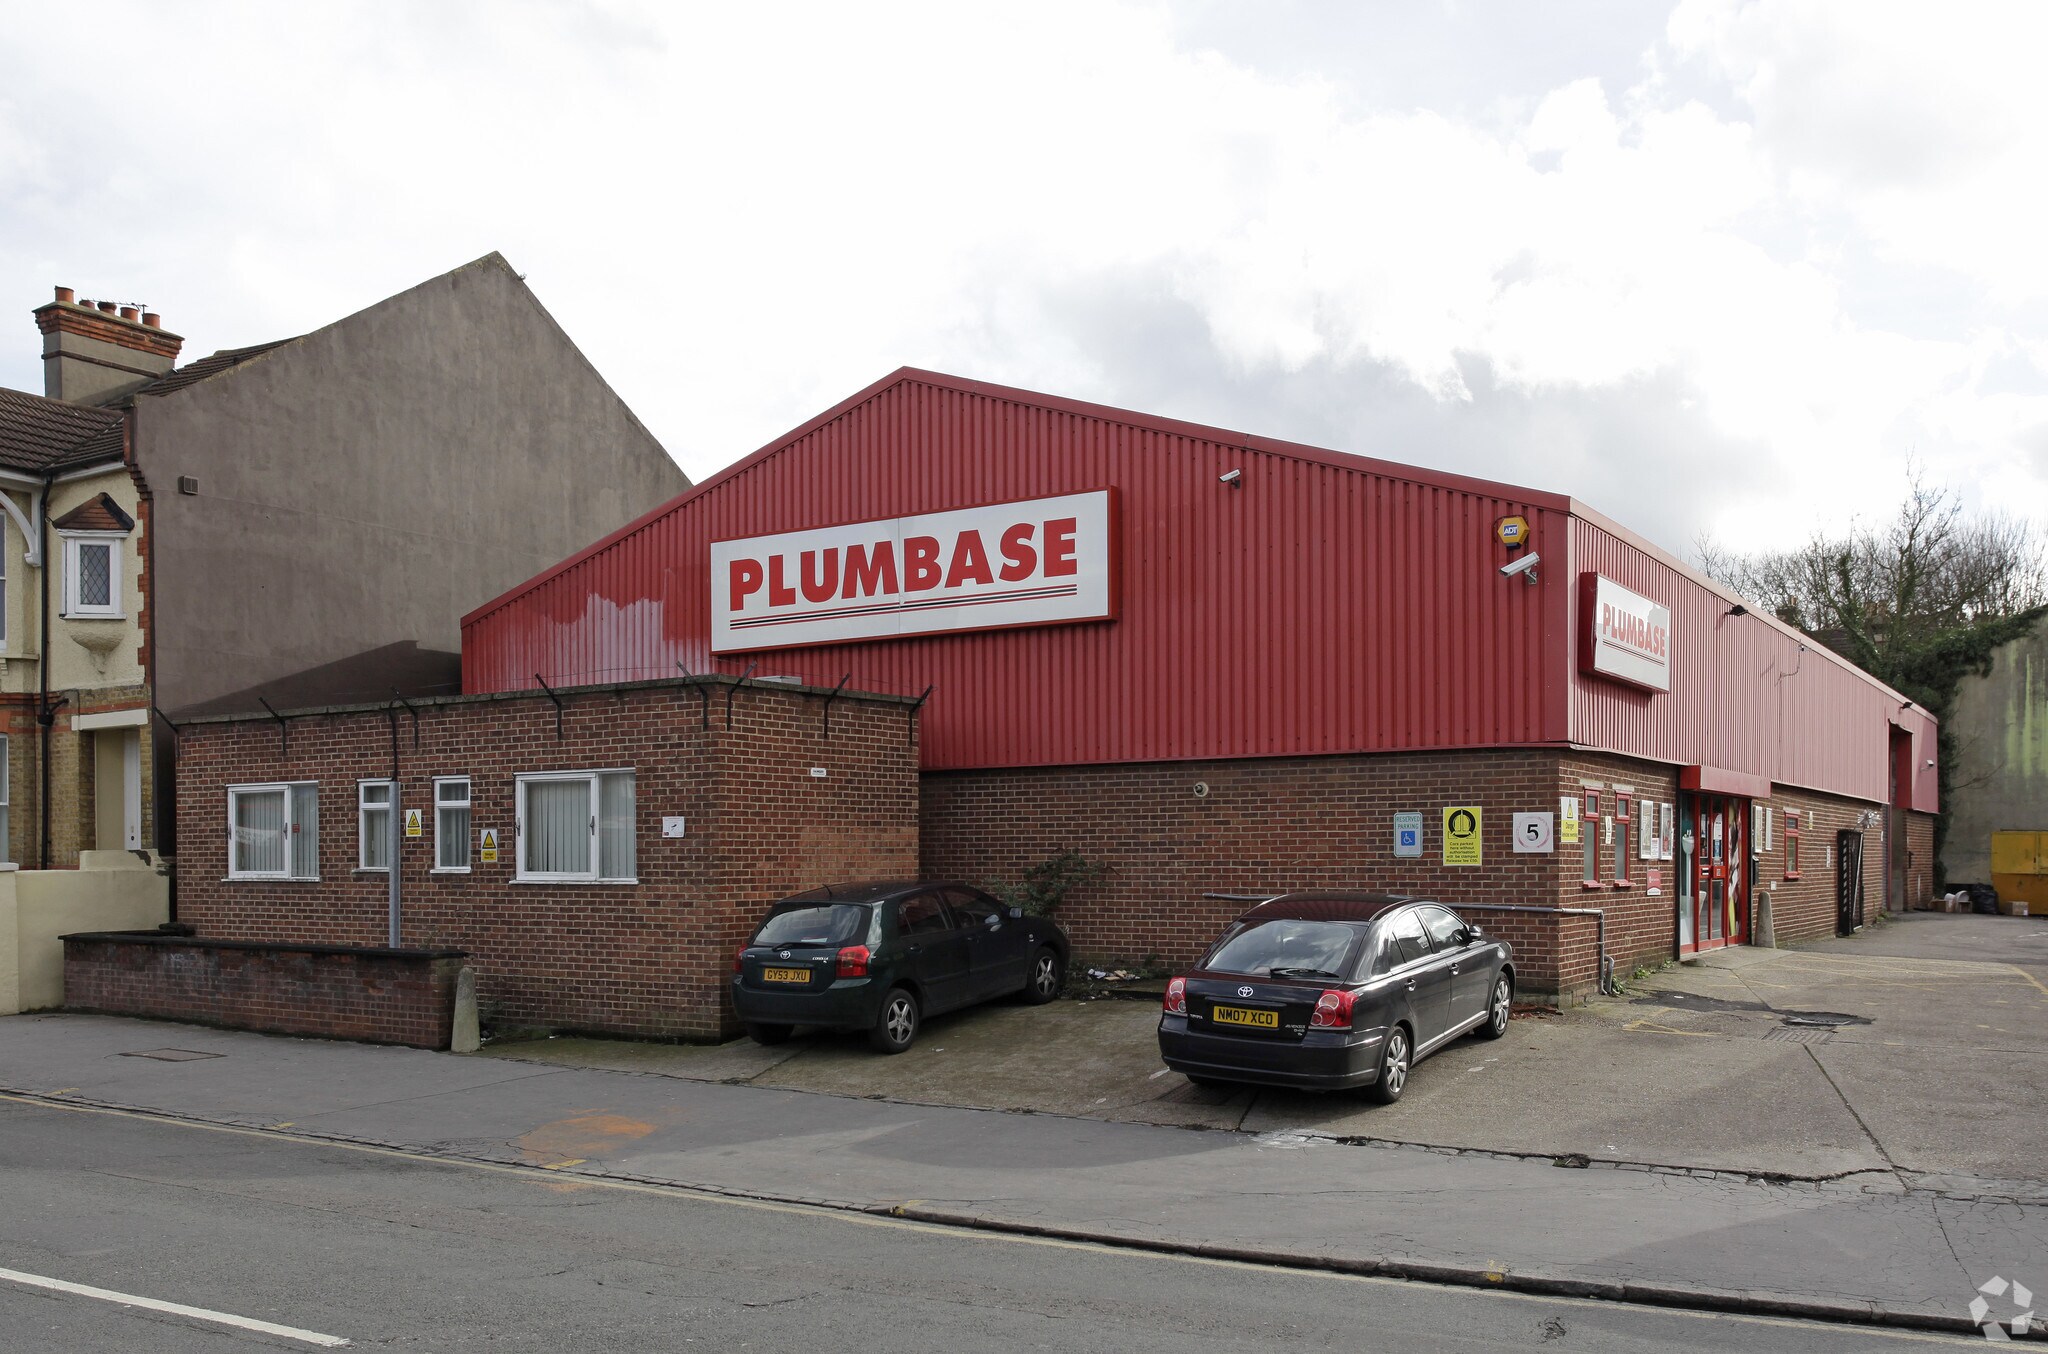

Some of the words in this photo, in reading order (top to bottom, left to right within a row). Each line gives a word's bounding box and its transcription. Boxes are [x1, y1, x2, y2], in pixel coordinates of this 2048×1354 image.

[1503, 526, 1518, 535] ADT
[729, 517, 1078, 612] PLUMBASE
[1602, 602, 1666, 658] PLUMBASE
[1396, 815, 1420, 823] RESERVED
[1526, 823, 1539, 842] 5
[767, 970, 788, 980] GY53
[790, 971, 807, 981] JXU
[1218, 1008, 1248, 1022] NM07
[1250, 1012, 1273, 1025] XCO
